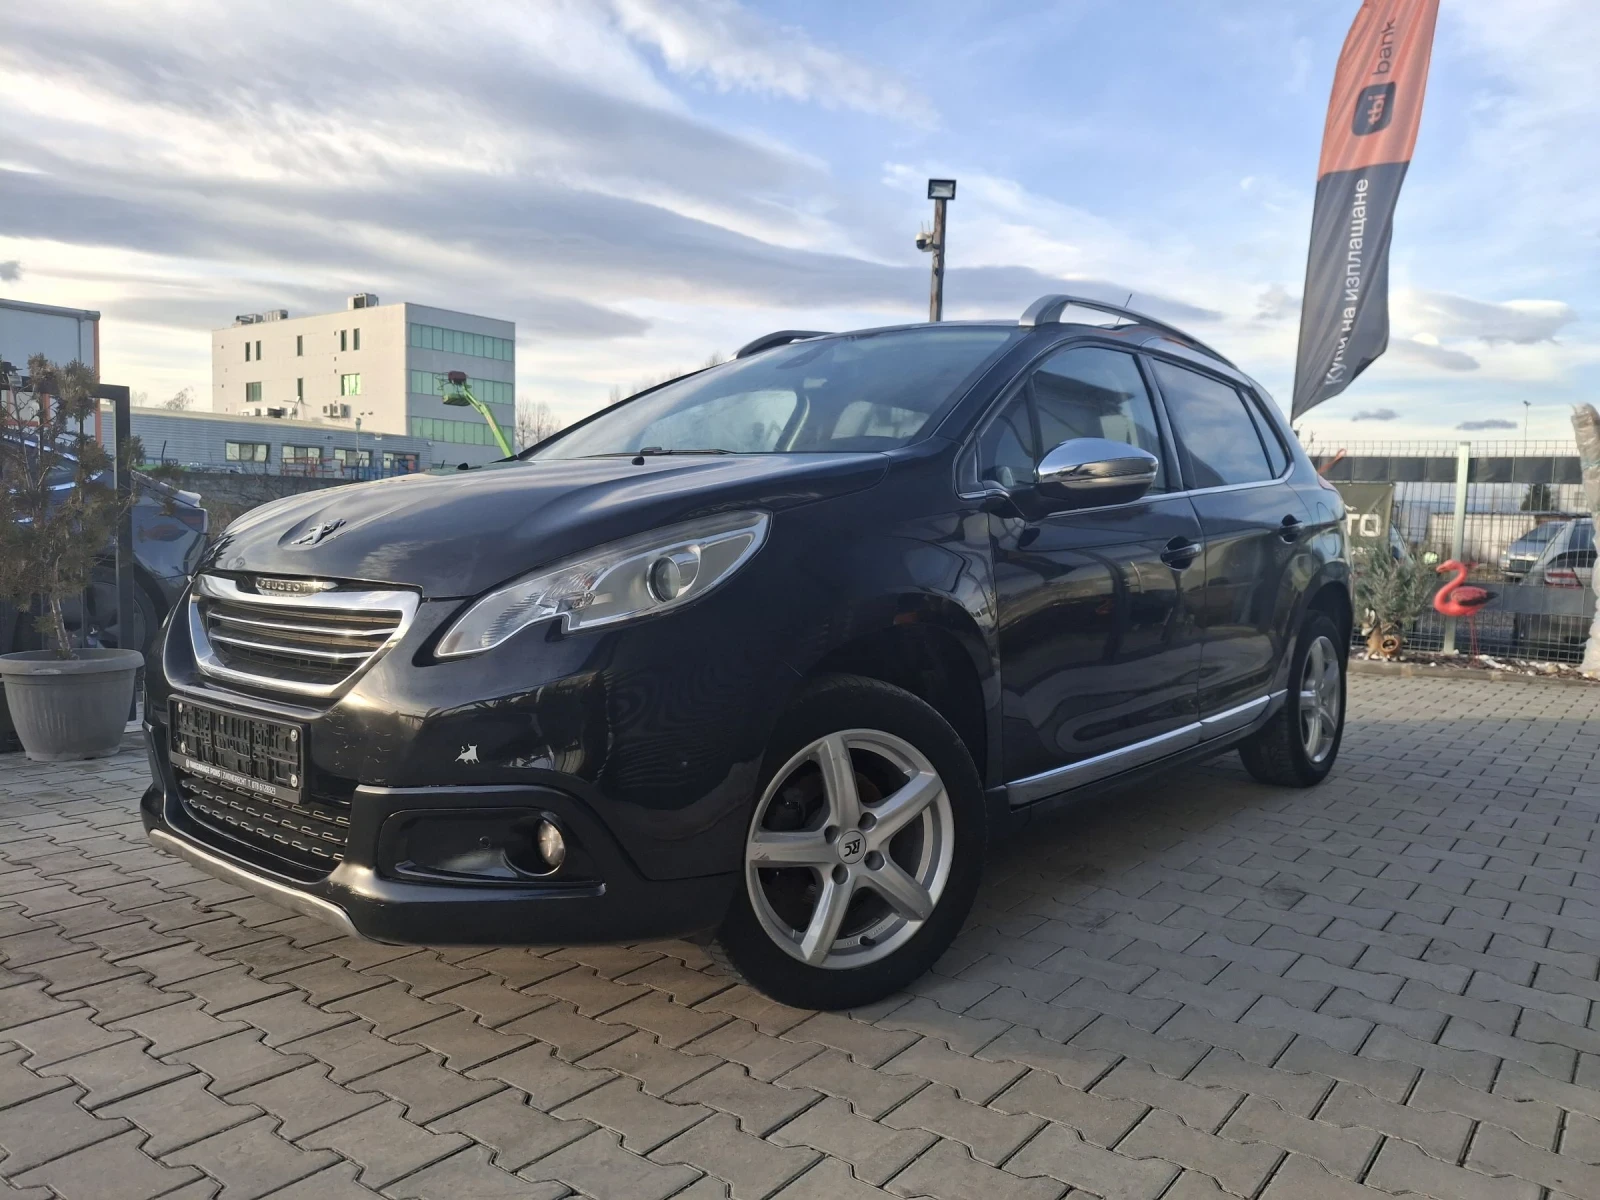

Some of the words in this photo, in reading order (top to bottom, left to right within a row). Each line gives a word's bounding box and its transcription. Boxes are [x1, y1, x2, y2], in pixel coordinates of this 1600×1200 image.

[1372, 17, 1396, 76] bank
[1367, 94, 1386, 125] tbi
[1344, 179, 1368, 302] изплащане
[1341, 306, 1356, 332] на
[1325, 336, 1348, 385] Купи
[260, 580, 308, 592] PEUGEOT
